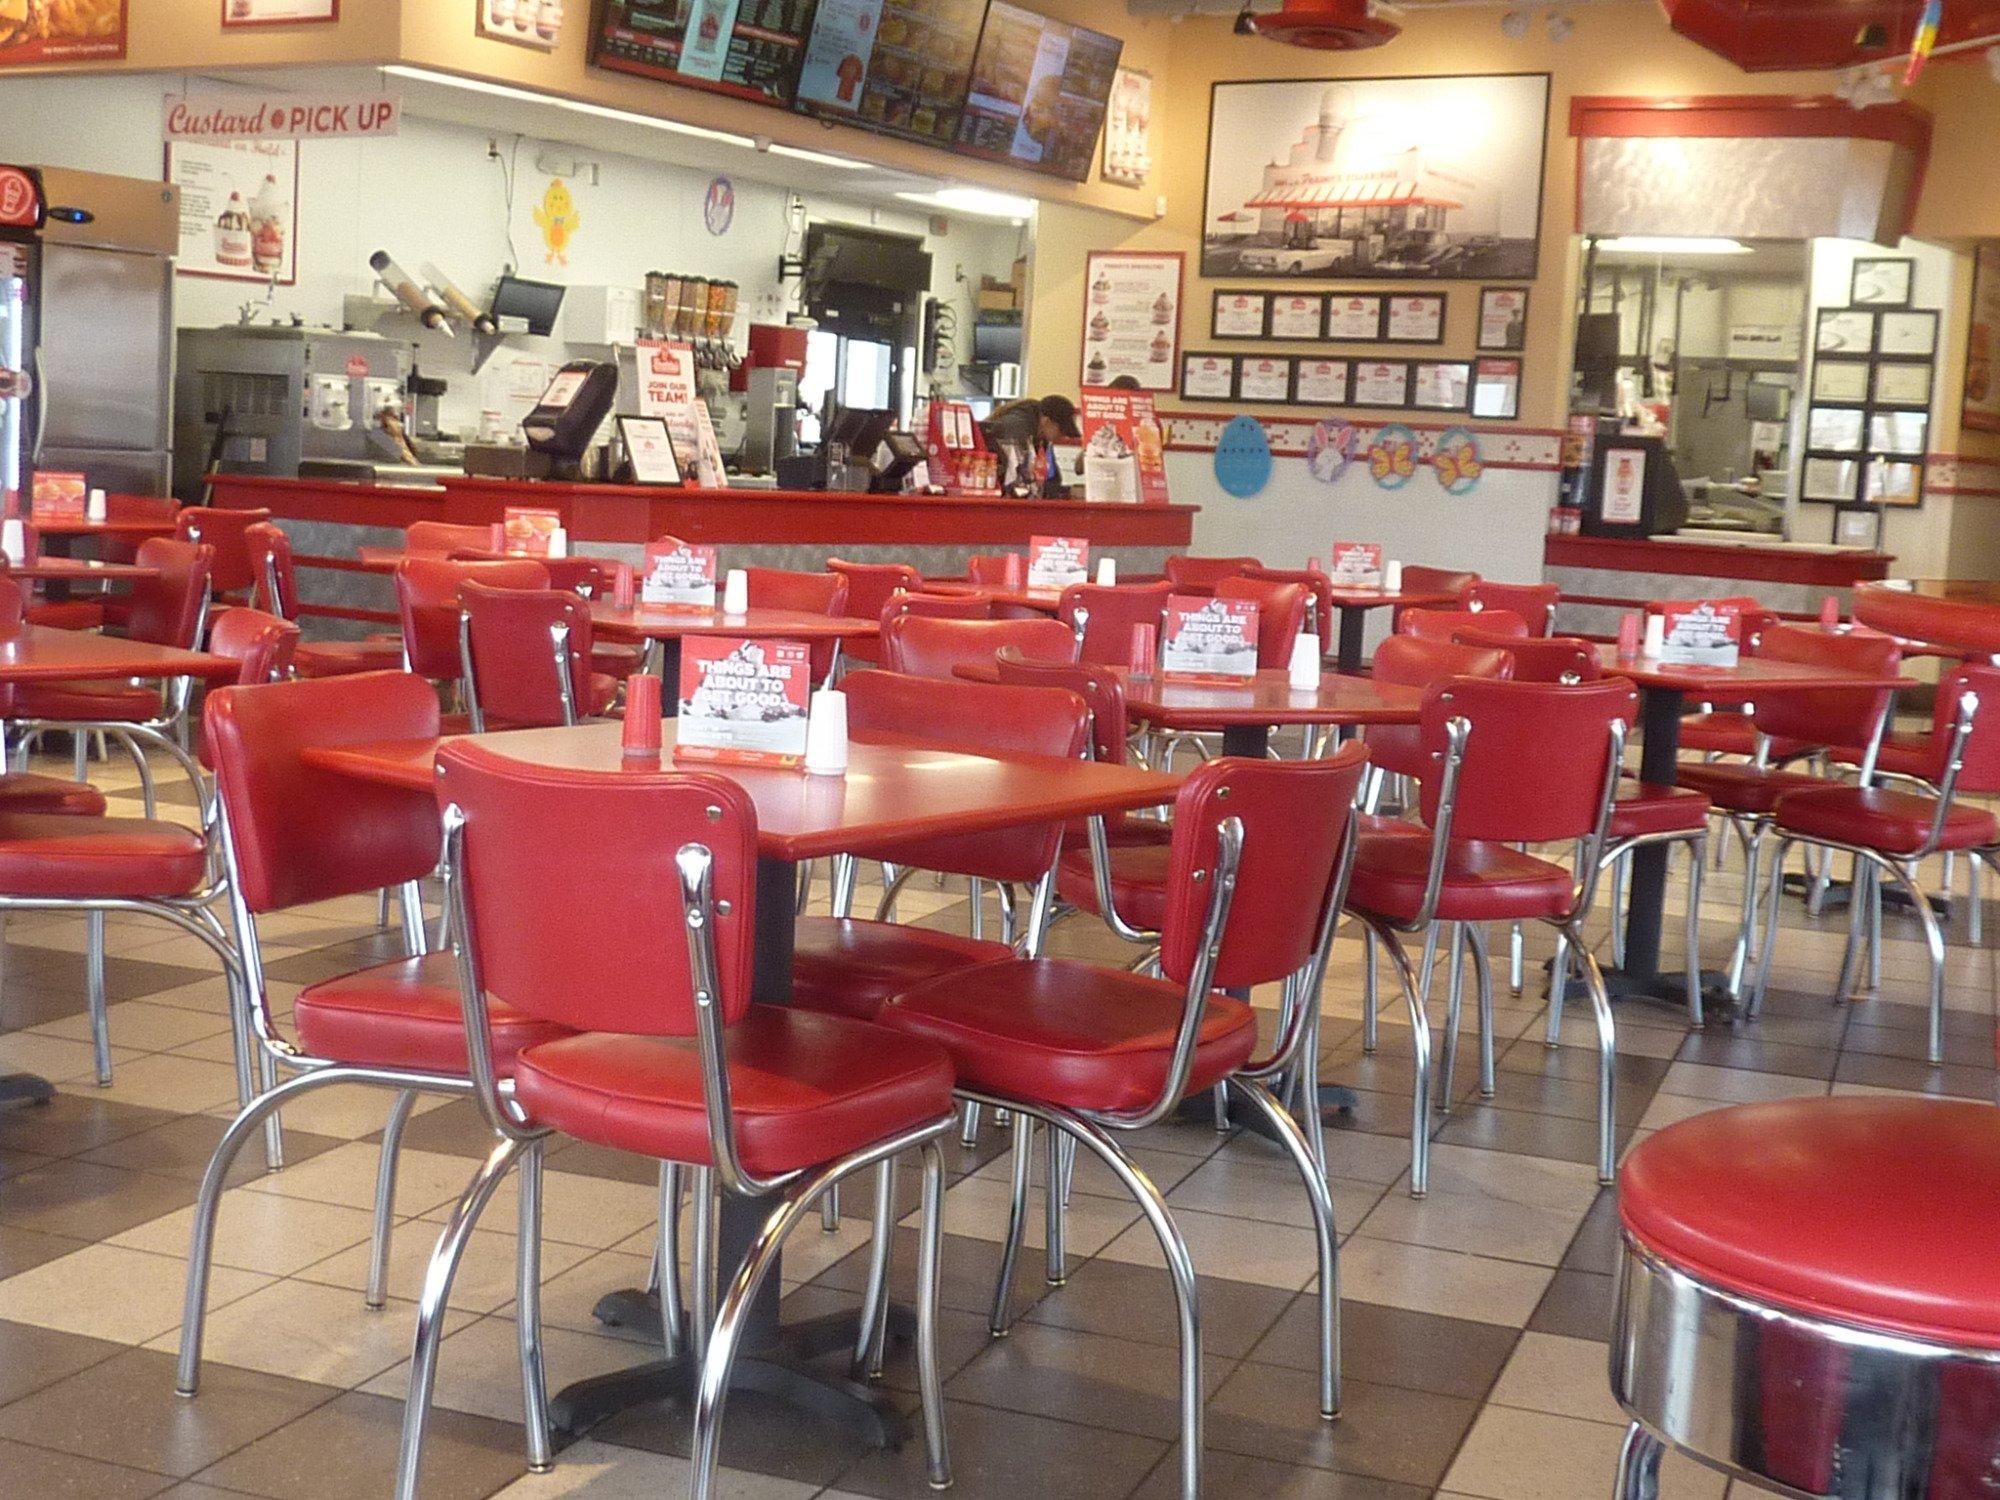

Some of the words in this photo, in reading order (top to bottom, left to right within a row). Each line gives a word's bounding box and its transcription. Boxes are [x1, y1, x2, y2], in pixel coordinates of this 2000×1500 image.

[168, 102, 267, 135] Custard
[290, 105, 349, 132] PICK
[357, 102, 392, 130] UP
[647, 381, 667, 389] JOIN
[647, 390, 688, 404] TEAM!
[696, 659, 757, 677] THINGS
[757, 664, 792, 679] ARE
[702, 674, 758, 691] ABOUT
[759, 677, 785, 693] TO
